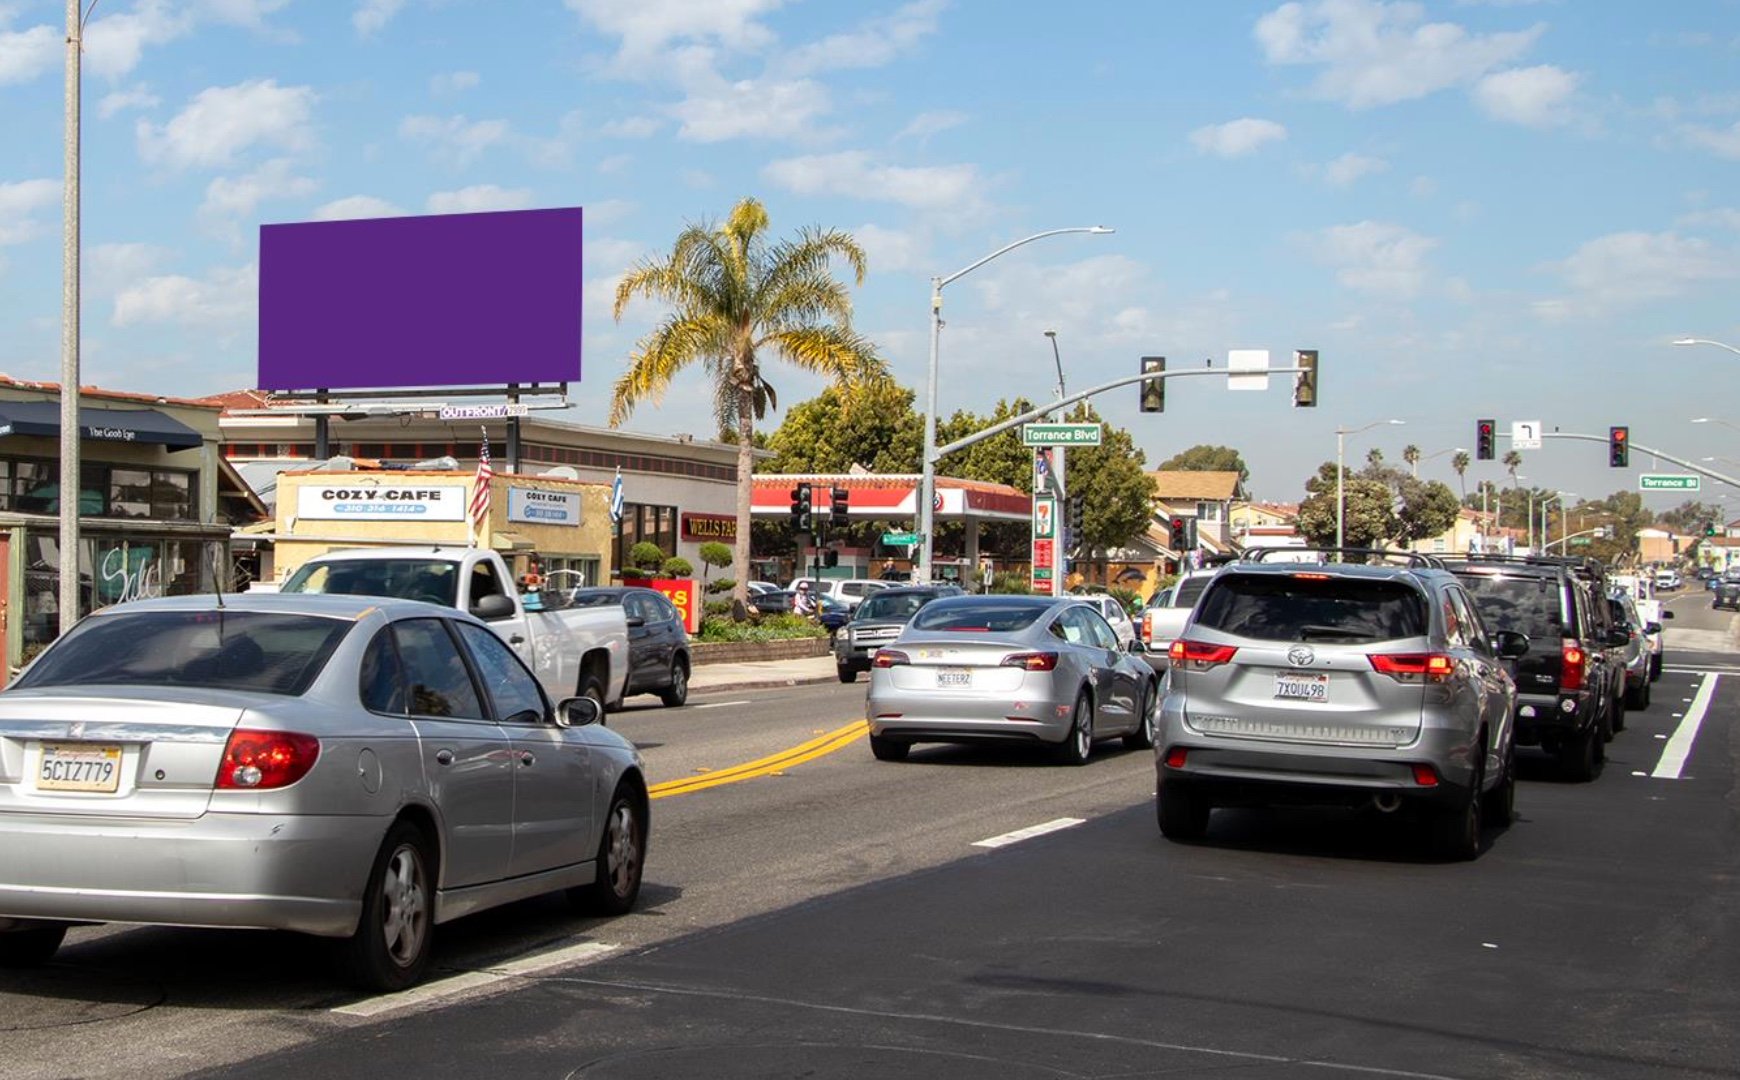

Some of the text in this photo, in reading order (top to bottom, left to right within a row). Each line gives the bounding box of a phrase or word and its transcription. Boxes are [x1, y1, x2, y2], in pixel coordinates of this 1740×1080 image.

[1027, 429, 1097, 441] Torrance Blvd
[1643, 478, 1683, 488] Torrance
[321, 489, 441, 501] COZY CAFE
[526, 492, 567, 503] COZY CAFE
[688, 518, 737, 537] WELLS FAR
[43, 760, 114, 782] 5CIZ779
